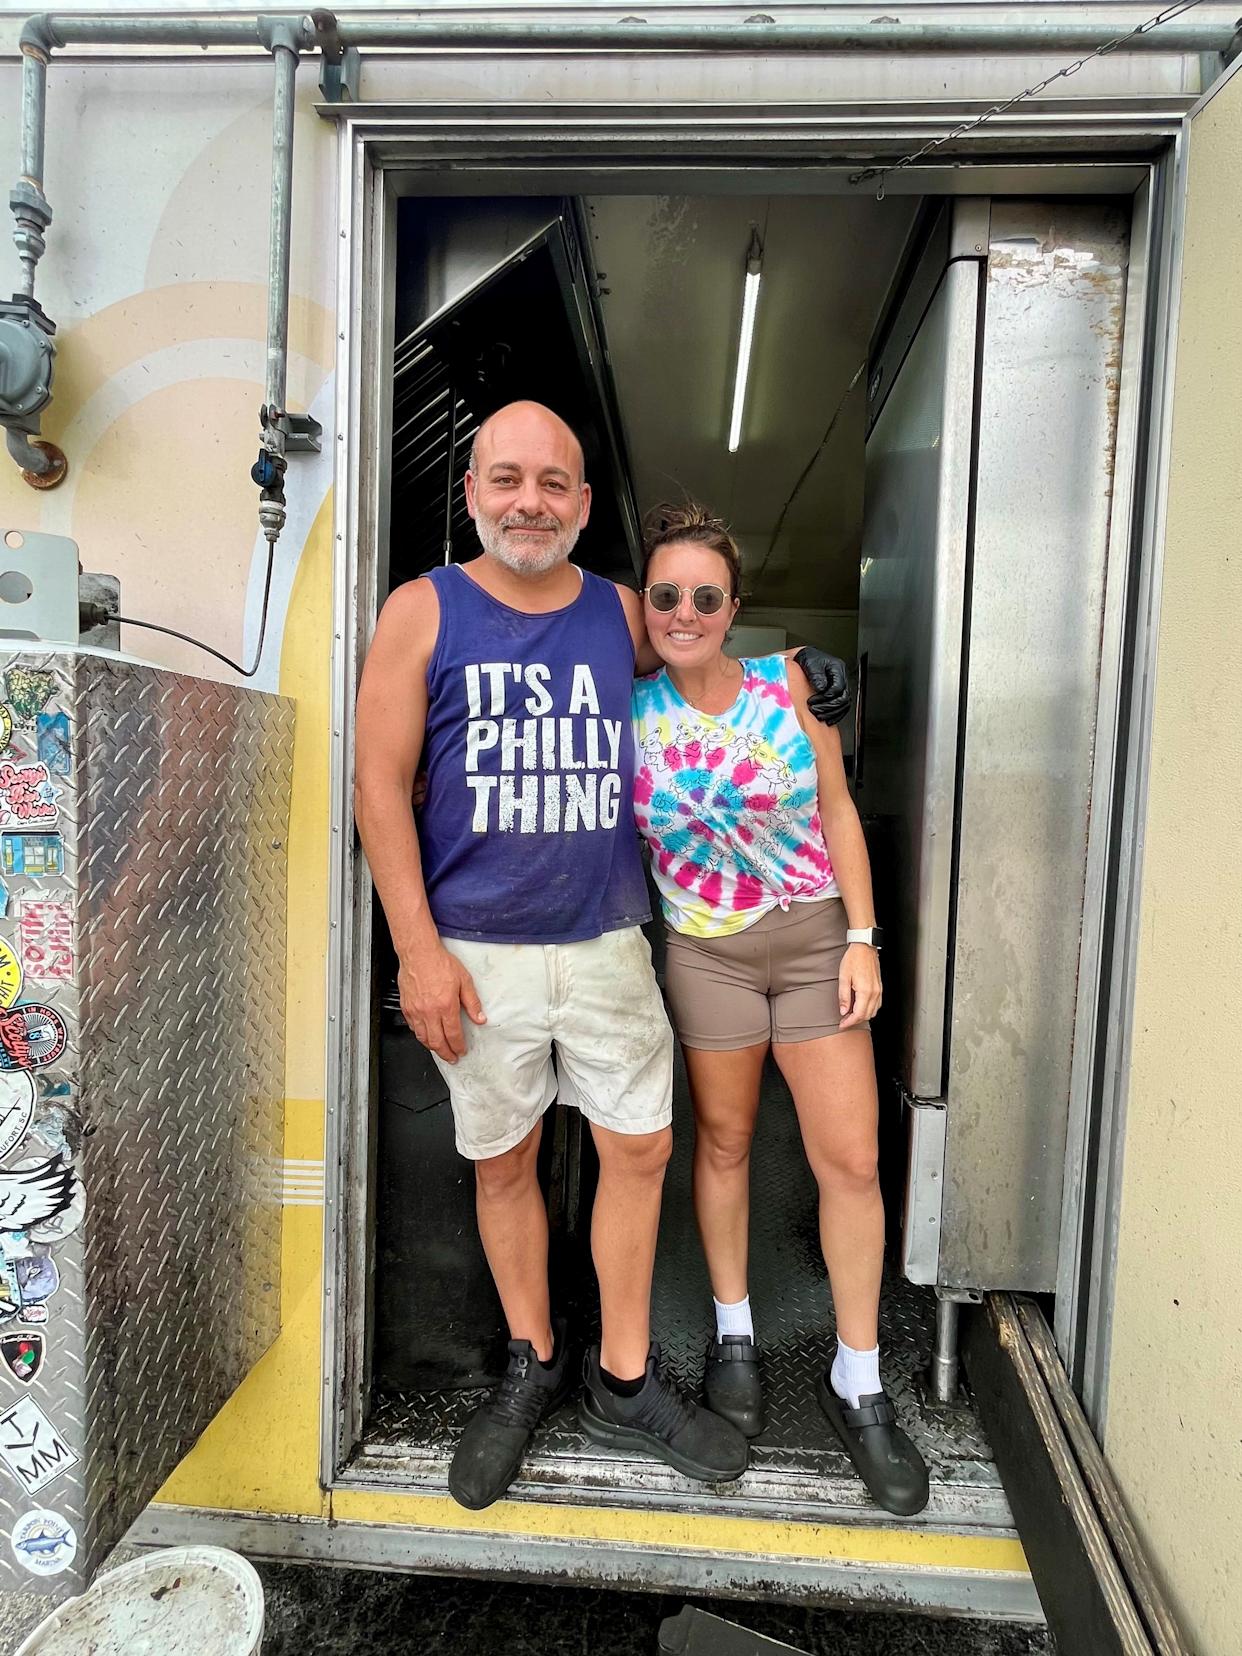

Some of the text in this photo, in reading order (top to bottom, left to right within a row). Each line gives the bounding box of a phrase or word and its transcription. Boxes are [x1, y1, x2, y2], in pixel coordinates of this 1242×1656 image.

[465, 663, 600, 718] IT'S A
[465, 717, 622, 772] PHILLY
[466, 773, 622, 833] THING
[40, 1008, 59, 1024] HOPE
[43, 1043, 62, 1061] TRUST
[19, 1111, 27, 1124] SC
[20, 1518, 64, 1540] TARPON POINT
